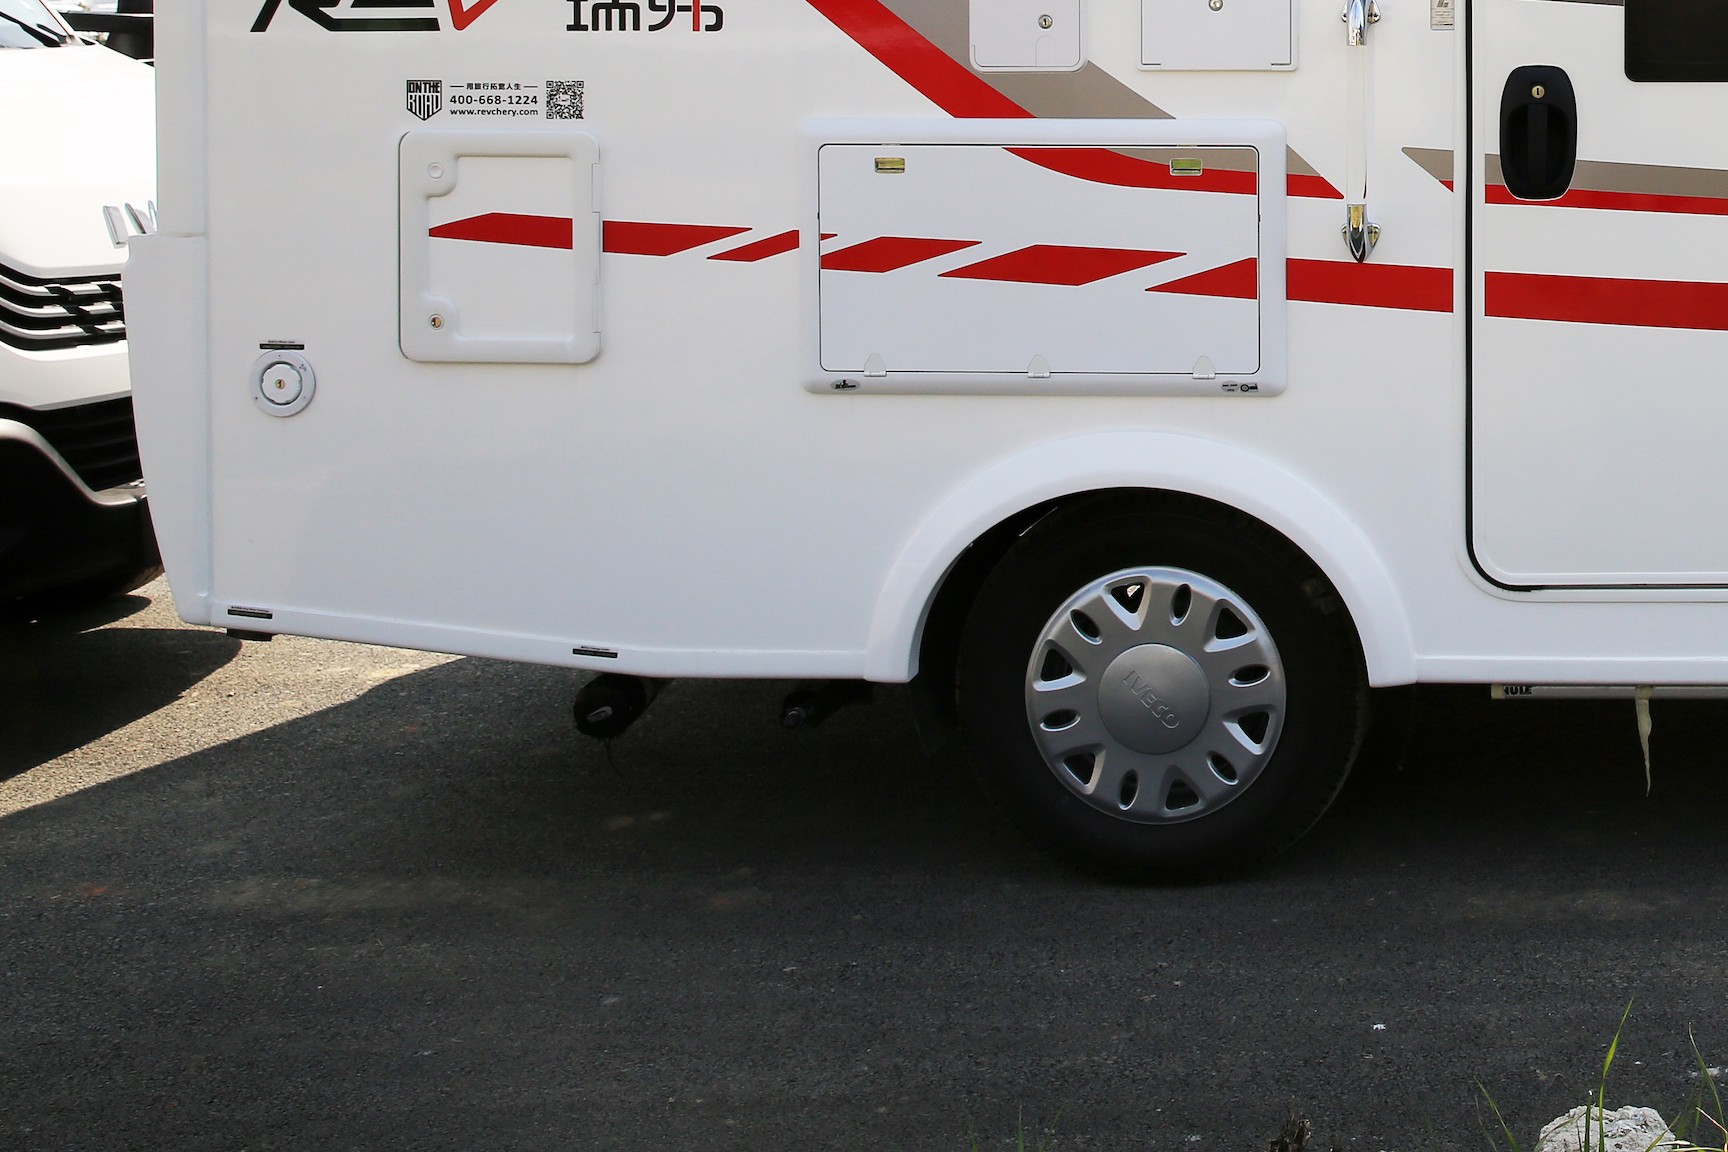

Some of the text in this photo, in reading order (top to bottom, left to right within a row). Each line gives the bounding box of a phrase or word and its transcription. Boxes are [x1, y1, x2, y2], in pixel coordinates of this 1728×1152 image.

[450, 95, 538, 105] 400-668-1224
[450, 108, 539, 116] www.revchery.com
[1123, 670, 1180, 729] IVECO
